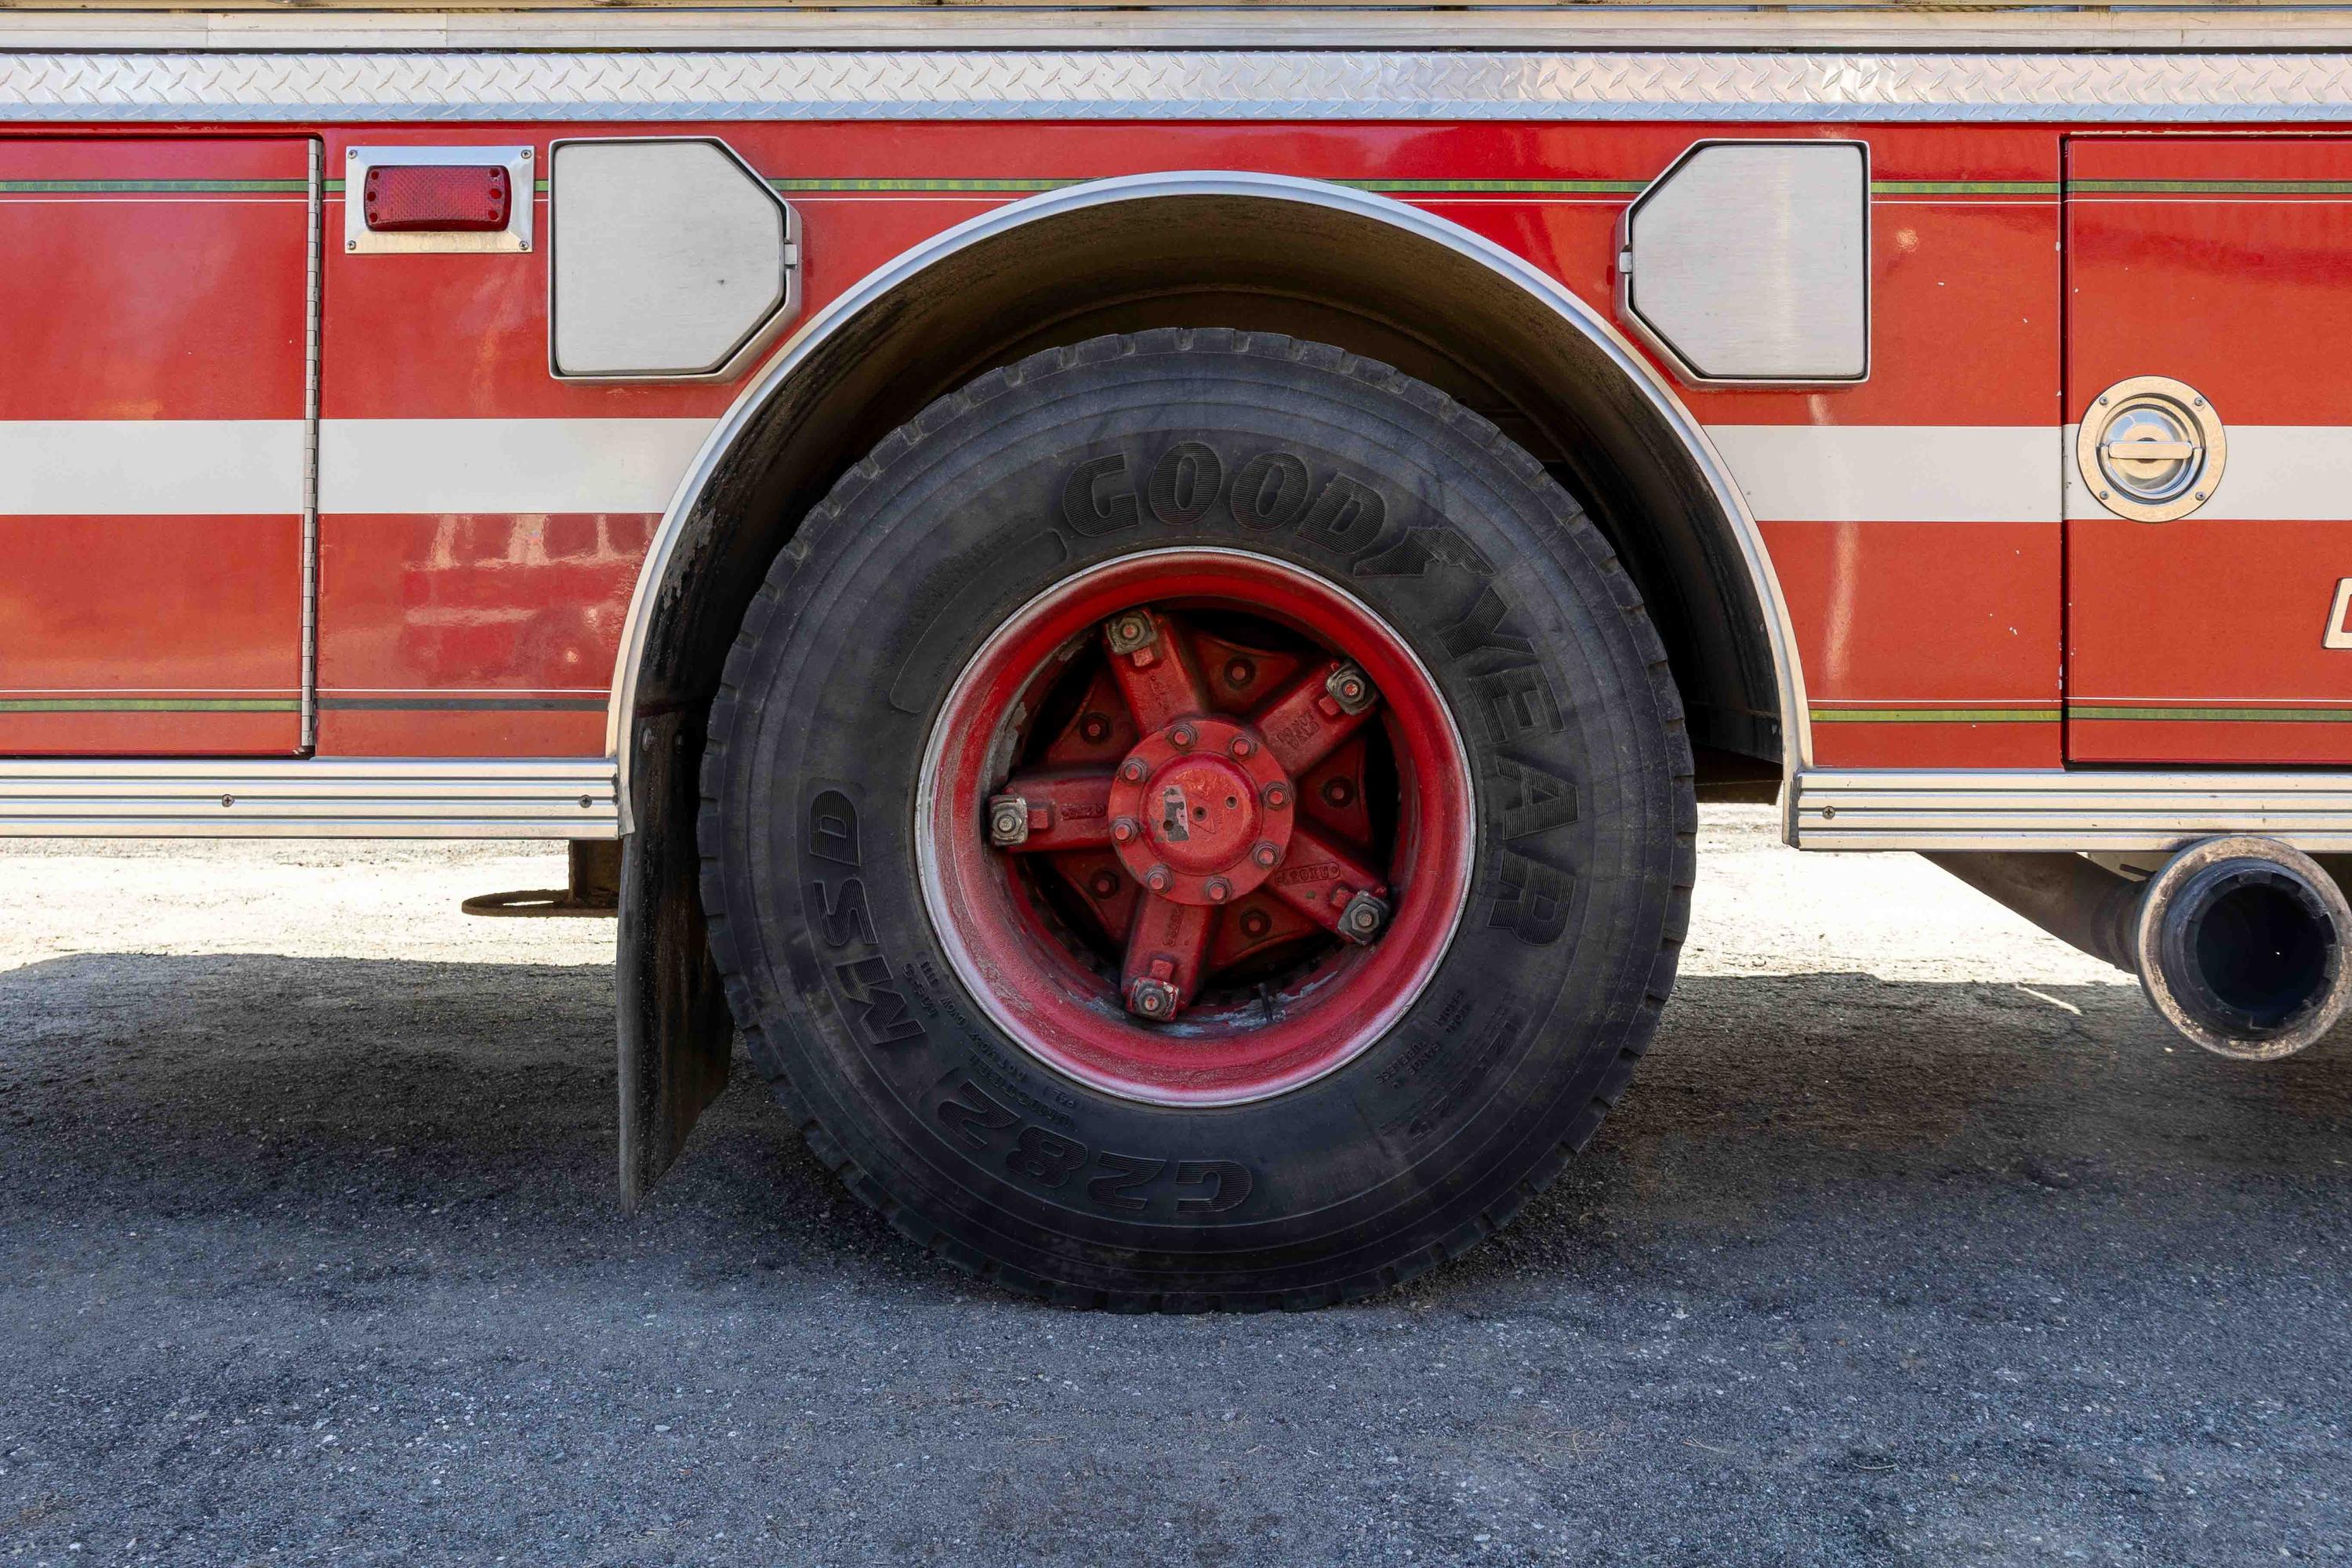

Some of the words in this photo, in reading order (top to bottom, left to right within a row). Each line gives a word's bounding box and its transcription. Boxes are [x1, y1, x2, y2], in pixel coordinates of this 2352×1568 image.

[1062, 441, 1581, 946] GOODYEAR
[809, 788, 927, 1044] MSD
[938, 1079, 1253, 1212] G282
[1372, 1036, 1427, 1085] TUBELESS
